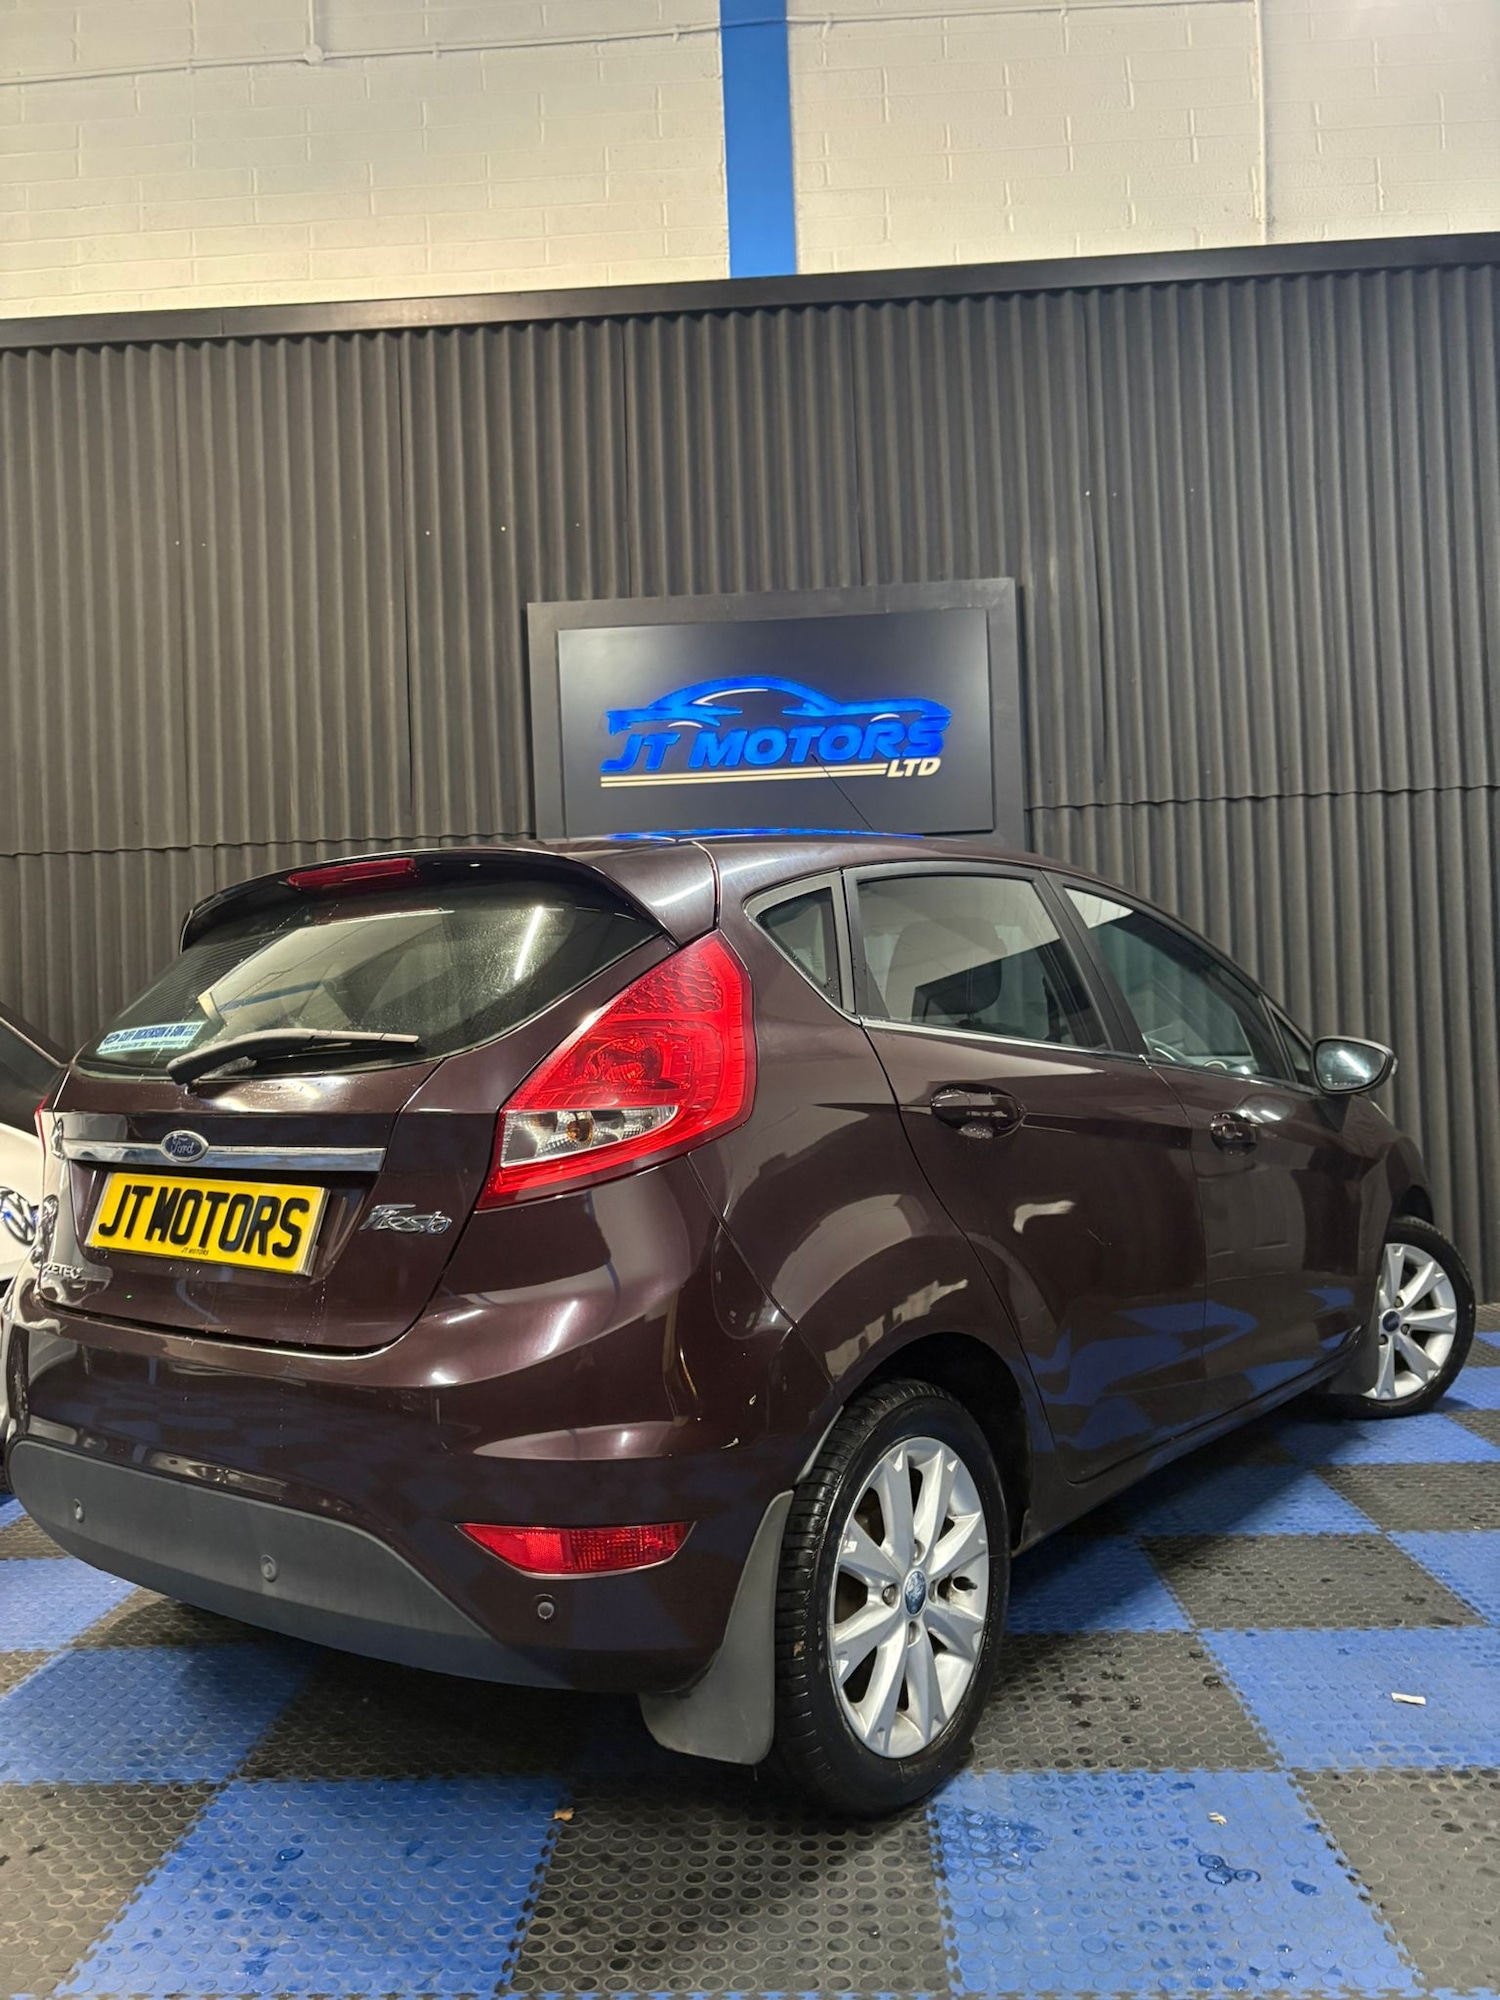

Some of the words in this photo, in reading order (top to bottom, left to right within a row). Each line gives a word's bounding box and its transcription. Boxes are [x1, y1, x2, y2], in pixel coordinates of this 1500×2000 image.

[601, 732, 681, 772] JT
[689, 716, 951, 768] MOTORS
[887, 757, 941, 778] LTD
[170, 1134, 195, 1154] Ford
[98, 1184, 154, 1240] JT
[144, 1186, 310, 1258] MOTORS
